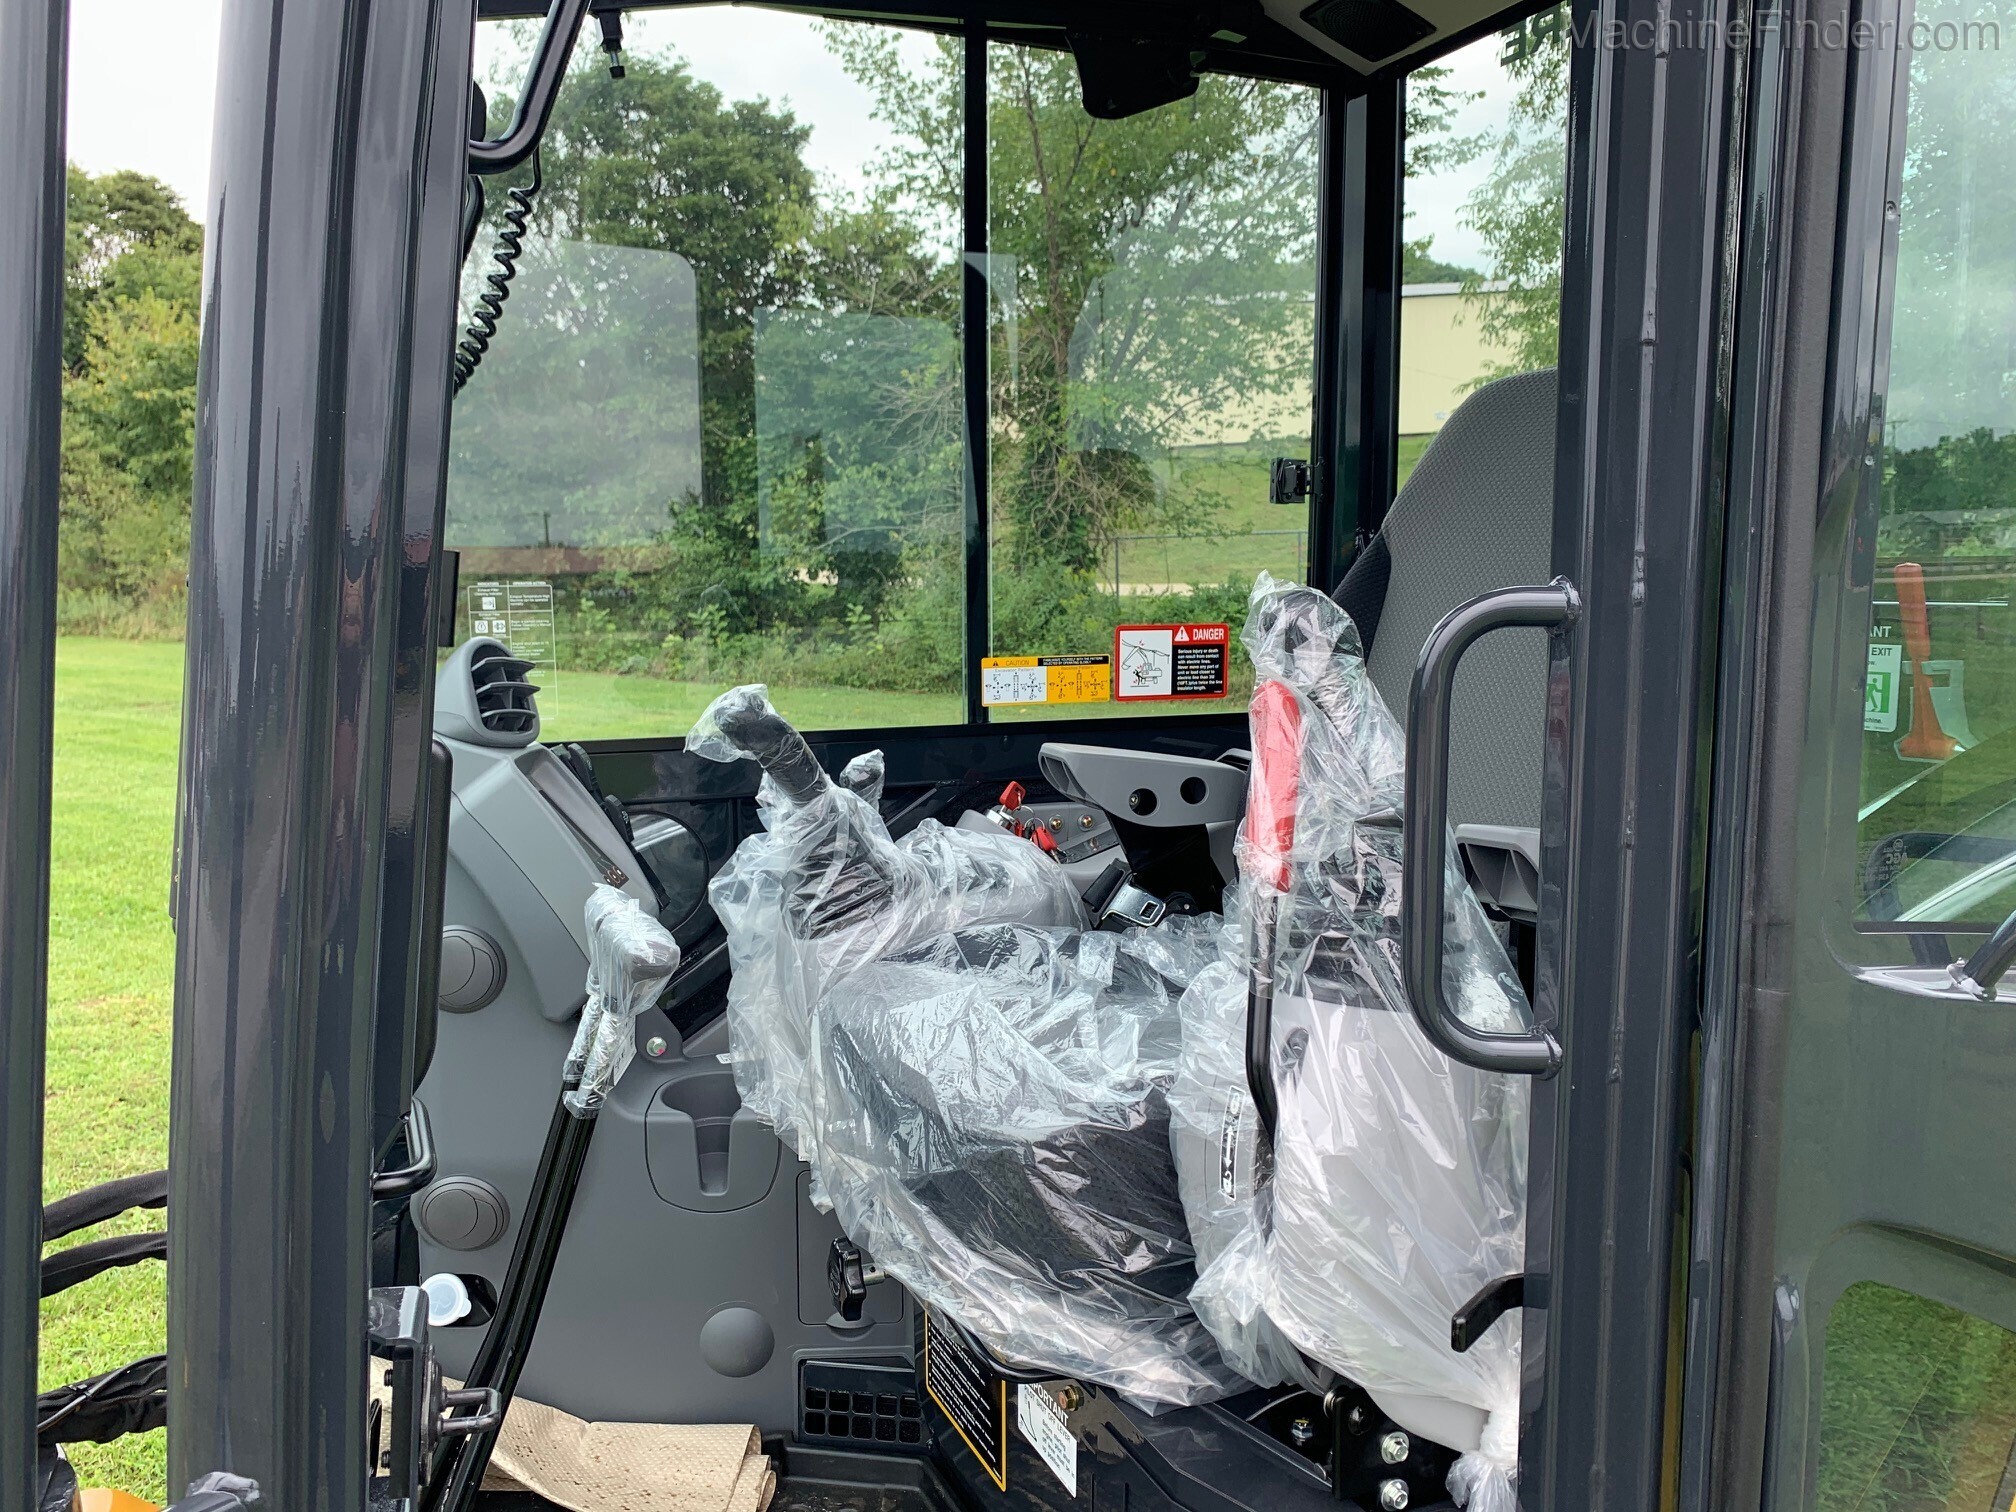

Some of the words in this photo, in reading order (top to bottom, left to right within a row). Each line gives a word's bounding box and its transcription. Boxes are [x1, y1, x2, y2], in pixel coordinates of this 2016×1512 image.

[1193, 628, 1224, 640] DANGER
[1871, 647, 1892, 656] EXIT
[1057, 1423, 1070, 1443] LEVER
